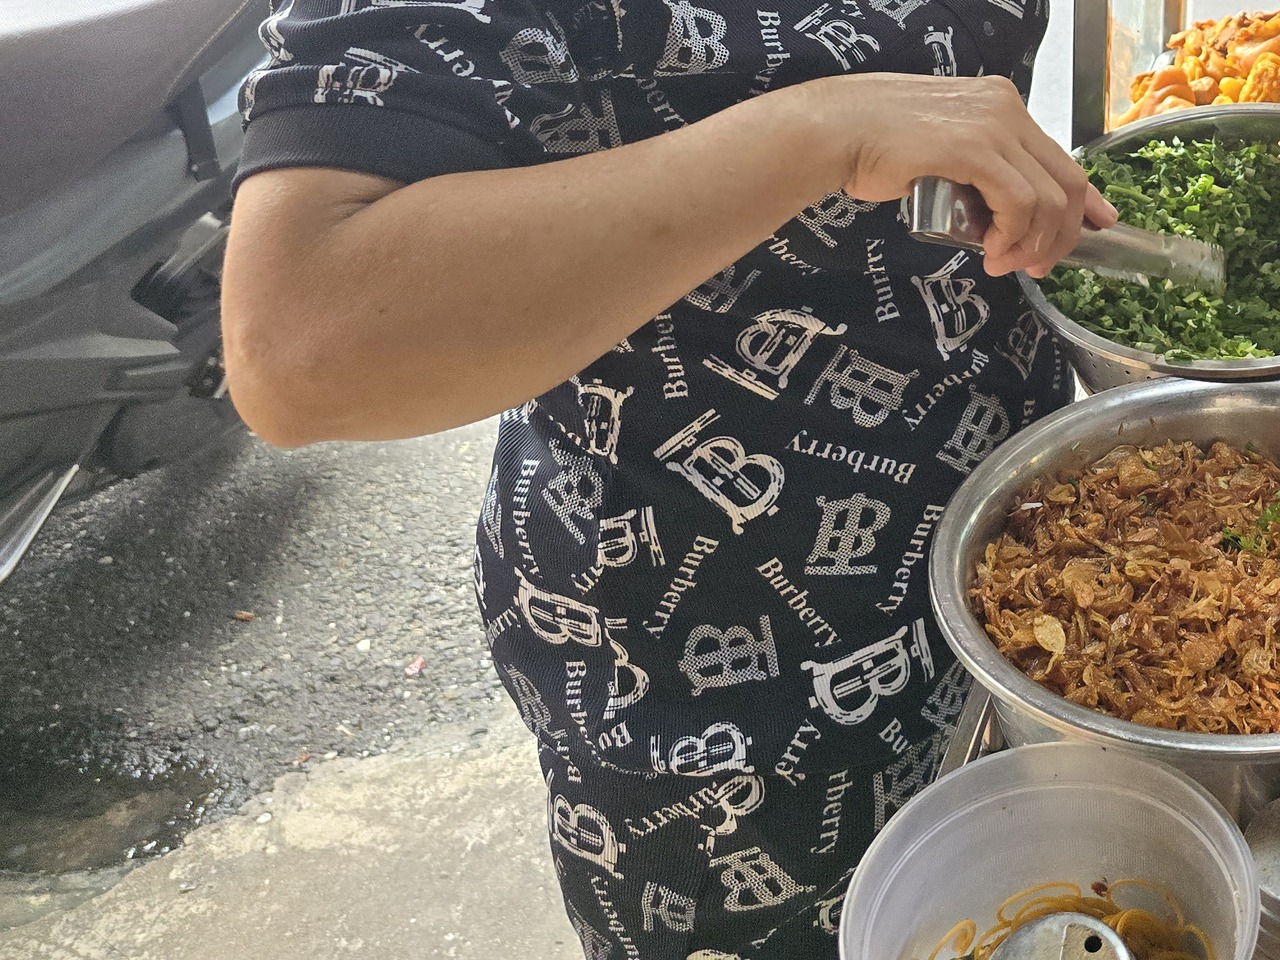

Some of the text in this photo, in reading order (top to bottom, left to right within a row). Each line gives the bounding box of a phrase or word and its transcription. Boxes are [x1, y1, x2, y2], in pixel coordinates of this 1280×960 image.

[784, 429, 918, 485] Burberry
[512, 459, 543, 579] Burberry
[875, 504, 946, 617] Burberry
[642, 535, 720, 639] Burberry
[756, 556, 842, 648] Burberry
